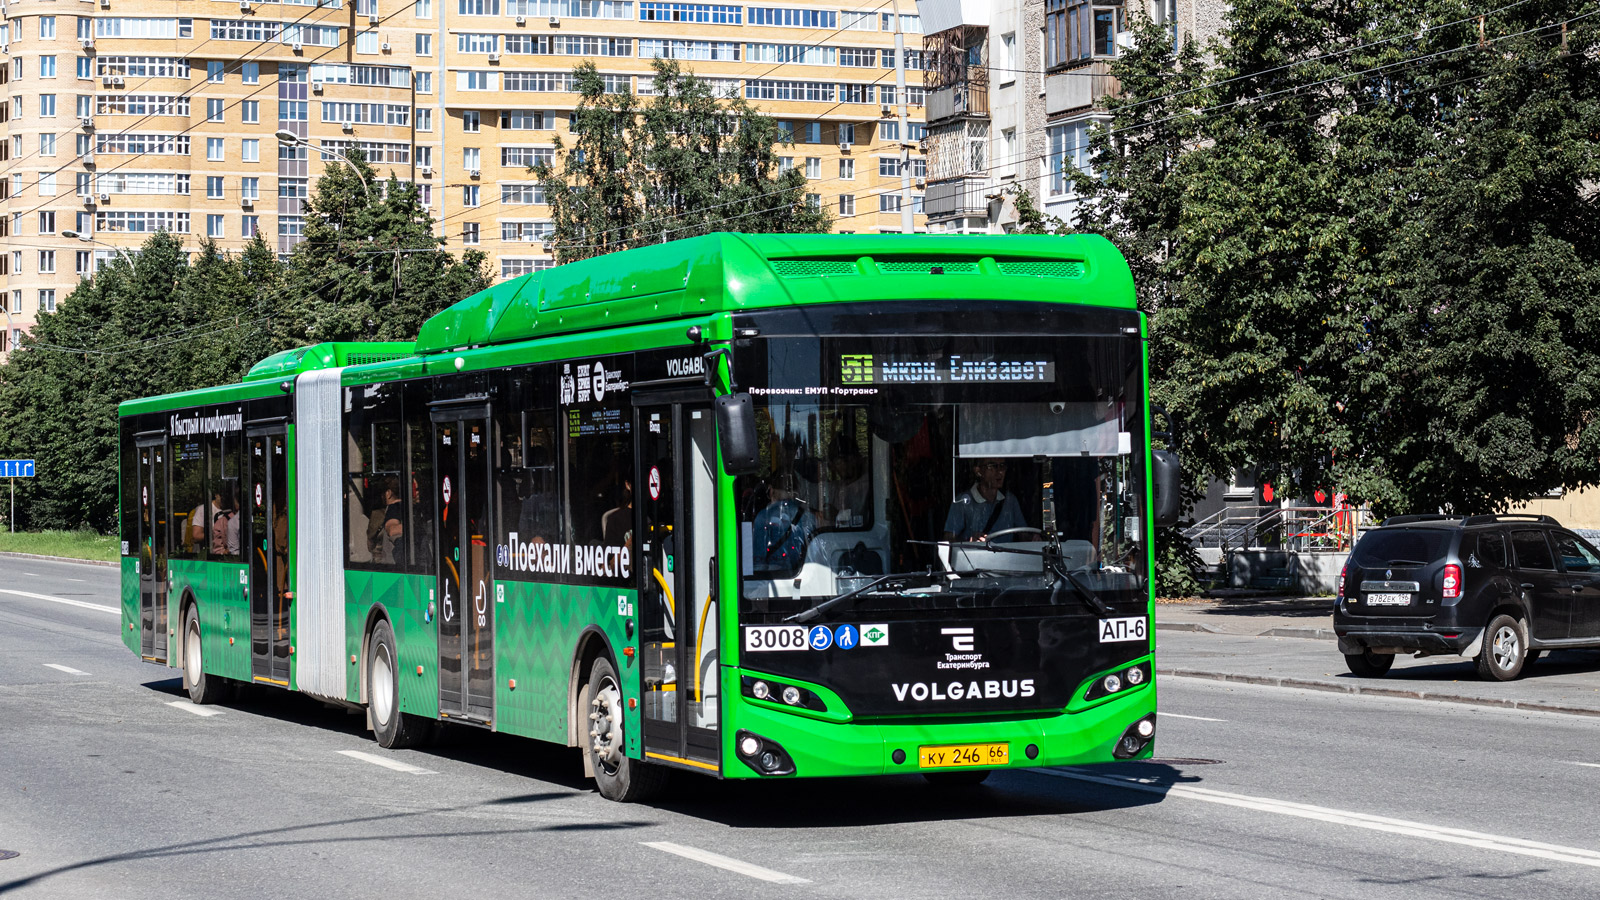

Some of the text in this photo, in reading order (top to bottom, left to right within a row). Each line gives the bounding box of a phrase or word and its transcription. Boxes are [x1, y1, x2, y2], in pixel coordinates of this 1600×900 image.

[666, 356, 704, 376] VOLGABU
[843, 356, 866, 381] 51
[950, 355, 1047, 381] Елизавет
[748, 387, 878, 396] Перевозчик: ЕМУП «Гортранс»
[170, 406, 243, 441] Я быстрый и комфортный
[508, 531, 630, 579] Поехали вместе
[750, 629, 805, 648] 3008
[867, 631, 881, 639] КПГ
[1101, 619, 1144, 640] АП-6
[937, 661, 990, 670] Екатеринбурга
[945, 653, 982, 662] Транспорт
[891, 679, 1036, 701] VOLGABUS
[953, 747, 980, 763] 246
[989, 746, 1003, 757] 66
